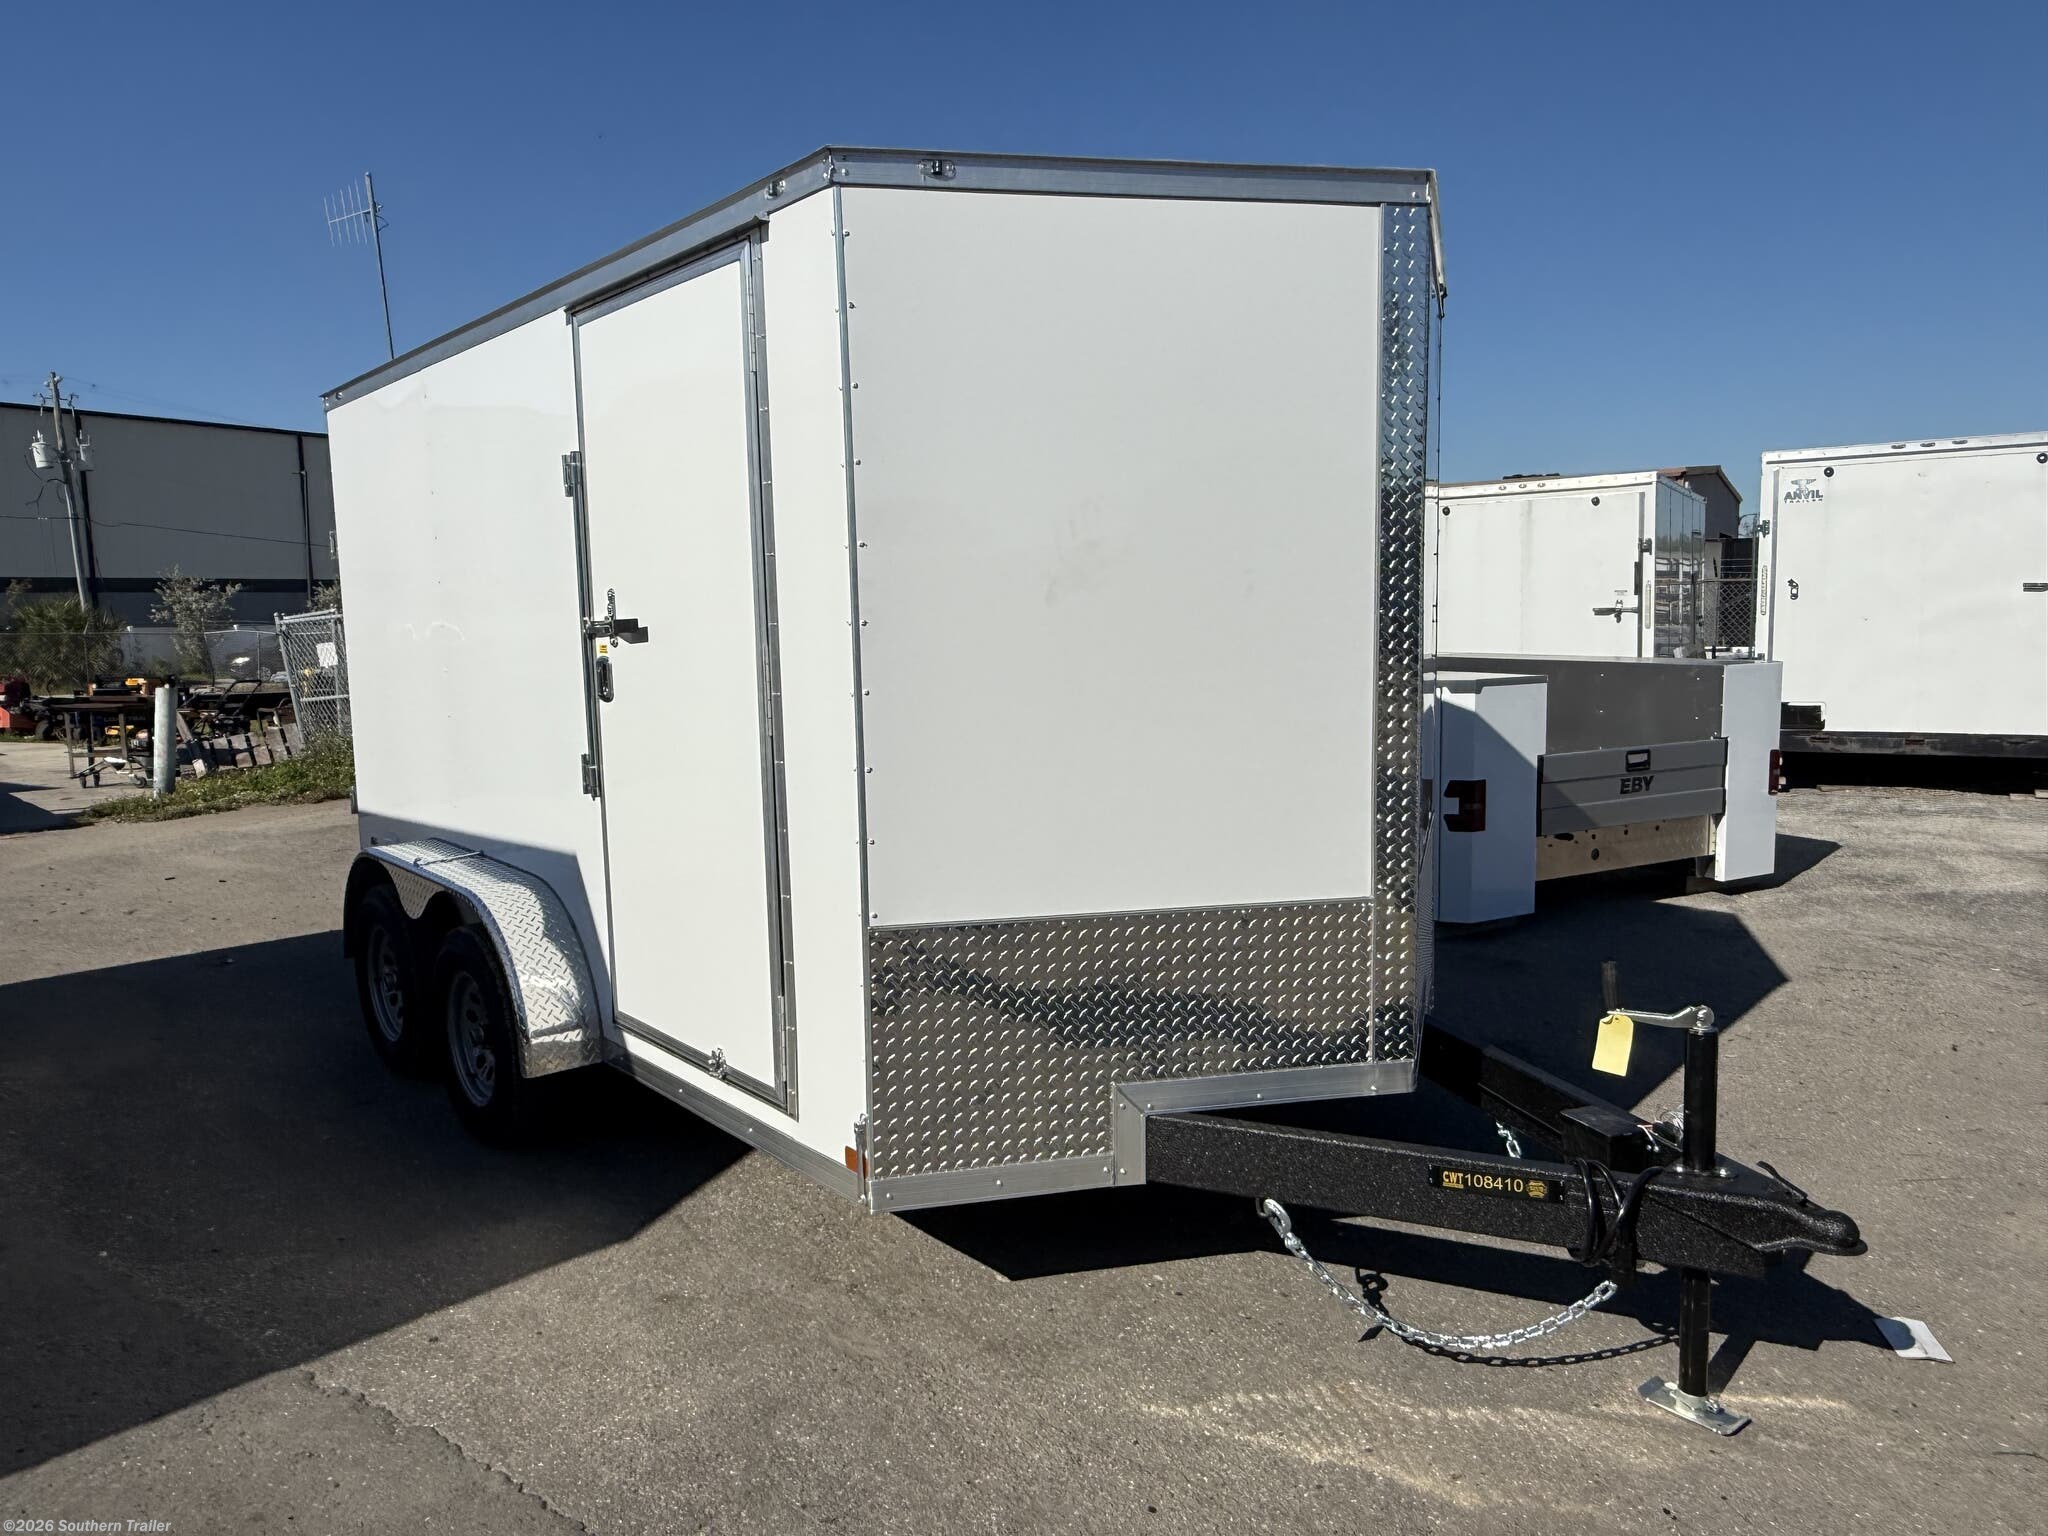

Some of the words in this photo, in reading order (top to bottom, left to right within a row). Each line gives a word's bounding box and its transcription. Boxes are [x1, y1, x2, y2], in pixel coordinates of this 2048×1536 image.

[1784, 490, 1823, 501] ANVIL
[1620, 775, 1655, 794] EBY
[1464, 1173, 1524, 1193] 108410
